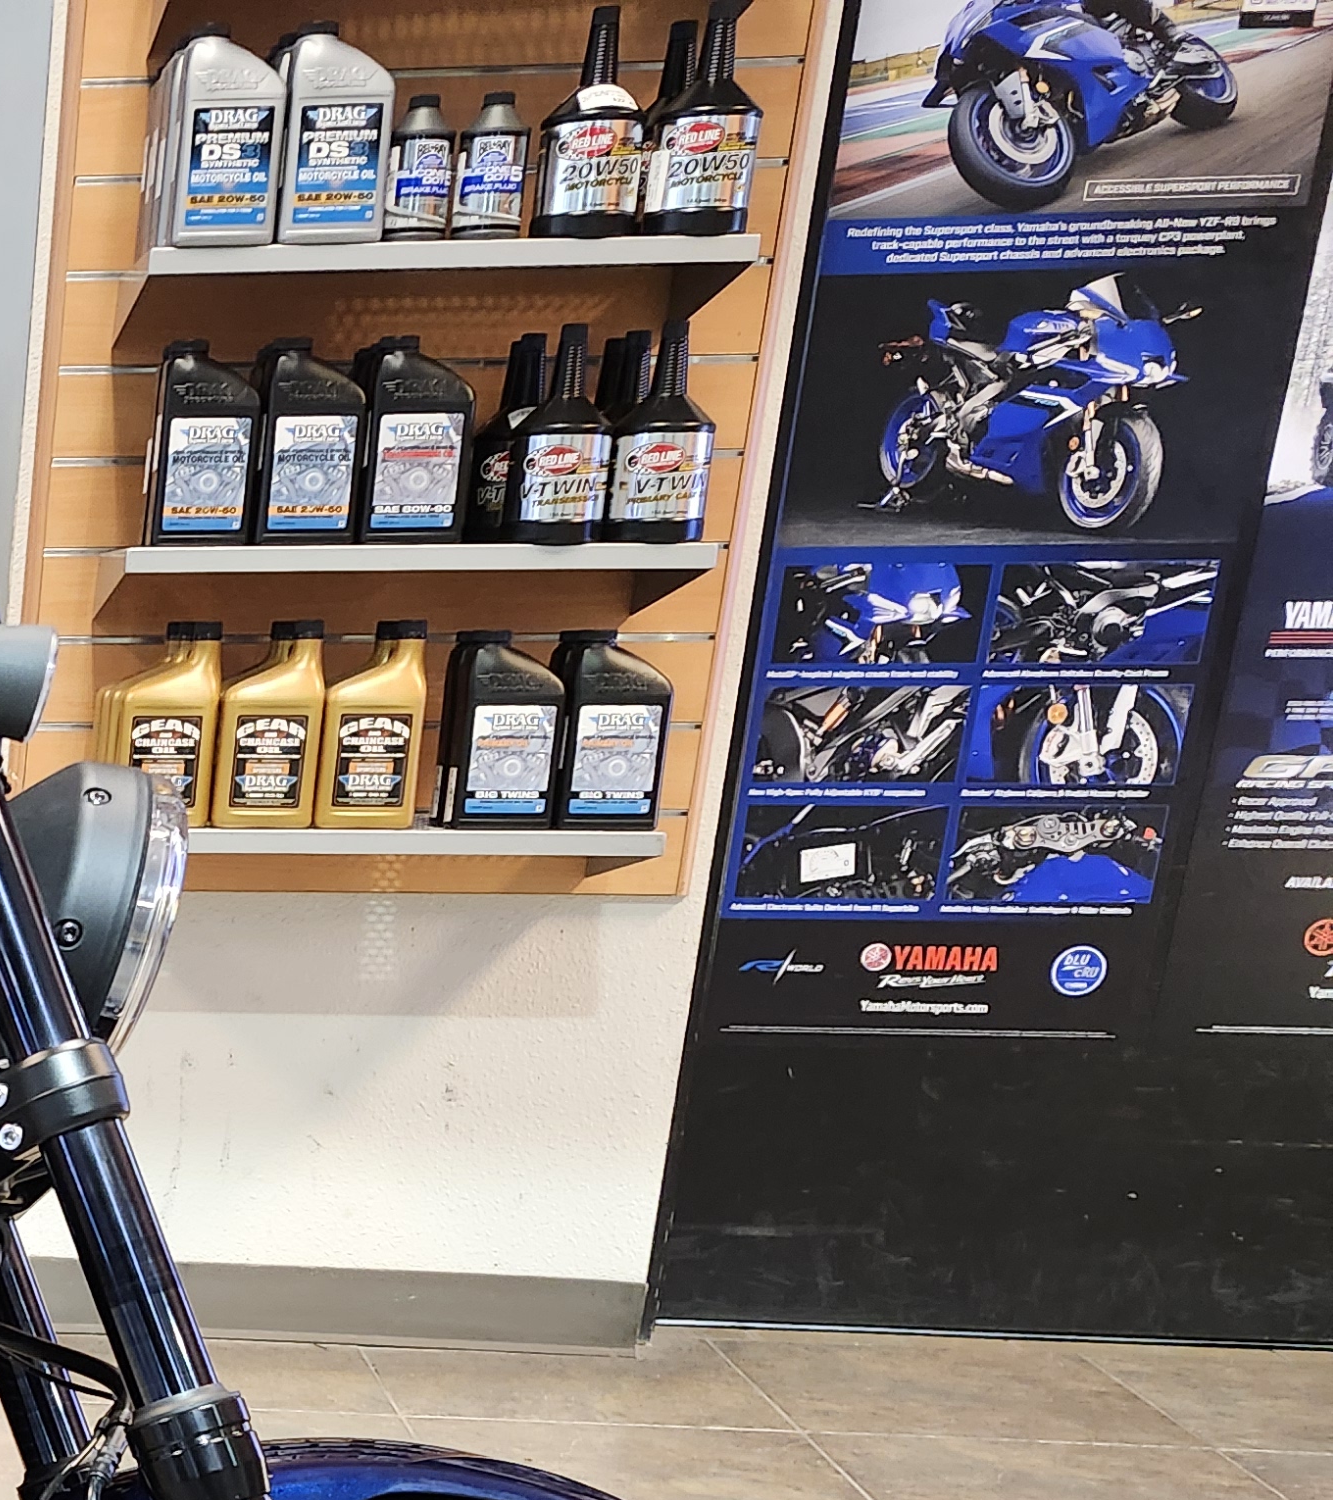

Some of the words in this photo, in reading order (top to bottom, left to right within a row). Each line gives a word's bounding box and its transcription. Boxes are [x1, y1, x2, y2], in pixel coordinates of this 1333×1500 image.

[209, 108, 259, 124] DRAG
[318, 105, 367, 122] DRAG
[195, 132, 270, 145] PREMIUM
[303, 130, 378, 143] PREMIUM
[571, 135, 591, 149] RED
[593, 133, 615, 147] LINE
[677, 129, 699, 145] RED
[700, 127, 723, 143] LINE
[200, 143, 262, 161] DS3
[309, 140, 370, 158] DS3
[201, 159, 260, 168] SYNTHETIC
[309, 156, 368, 166] SYNTHETIC
[668, 153, 750, 180] 20W50
[190, 171, 251, 184] MOTORCYCLE
[253, 171, 268, 182] OIL
[298, 169, 359, 183] MOTORCYCLE
[361, 169, 376, 180] OIL
[484, 173, 510, 184] DOT
[511, 165, 523, 182] 5
[560, 157, 639, 184] 20W50
[464, 183, 493, 194] BRAKE
[1093, 182, 1152, 195] ACCESSIBLE
[1154, 181, 1217, 193] SUPERSPORT
[1217, 179, 1290, 191] PERFORMANCE
[190, 195, 214, 204] SAE
[297, 193, 323, 202] SAE
[847, 226, 903, 238] Redefining
[905, 225, 922, 236] the
[924, 223, 983, 237] Supersport
[984, 223, 1015, 235] class,
[1017, 221, 1068, 233] Yamaha's
[1068, 219, 1153, 233] groundbreaking
[1154, 218, 1199, 229] All-New
[1199, 215, 1241, 227] YZF-R9
[1241, 215, 1277, 228] brings
[871, 239, 944, 251] track-capable
[945, 237, 1014, 250] performance
[1015, 236, 1027, 246] to
[1028, 236, 1046, 246] the
[1047, 235, 1079, 246] street
[1081, 233, 1105, 244] with
[1158, 231, 1182, 242] CP3
[1182, 230, 1245, 243] powerplant,
[885, 252, 938, 264] dedicated
[939, 251, 999, 264] Supersport
[999, 249, 1041, 261] chassis
[1042, 249, 1063, 260] and
[1063, 247, 1116, 259] advanced
[1116, 245, 1176, 257] electronics
[1177, 244, 1226, 257] package.
[188, 424, 235, 440] DRAG
[172, 454, 227, 464] MOTORCYCLE
[538, 455, 558, 466] RED
[559, 452, 580, 465] LINE
[661, 449, 684, 463] LINE
[521, 478, 597, 500] V-TWIN
[636, 474, 707, 494] V-TWIN
[131, 717, 201, 740] GEAR
[236, 717, 306, 740] GEAR
[339, 716, 411, 739] GEAR
[134, 738, 195, 747] CHAINCASE
[238, 737, 301, 747] CHAINCASE
[342, 736, 405, 746] CHAINCASE
[1235, 780, 1306, 789] RACING
[500, 790, 540, 799] TWINS
[605, 790, 645, 800] TWINS
[894, 945, 999, 972] YAMAHA
[786, 962, 826, 974] WORLD
[876, 974, 921, 990] Revs
[921, 974, 951, 989] Your
[951, 973, 987, 986] Heart
[859, 999, 989, 1015] YamahaMotorsports.com
